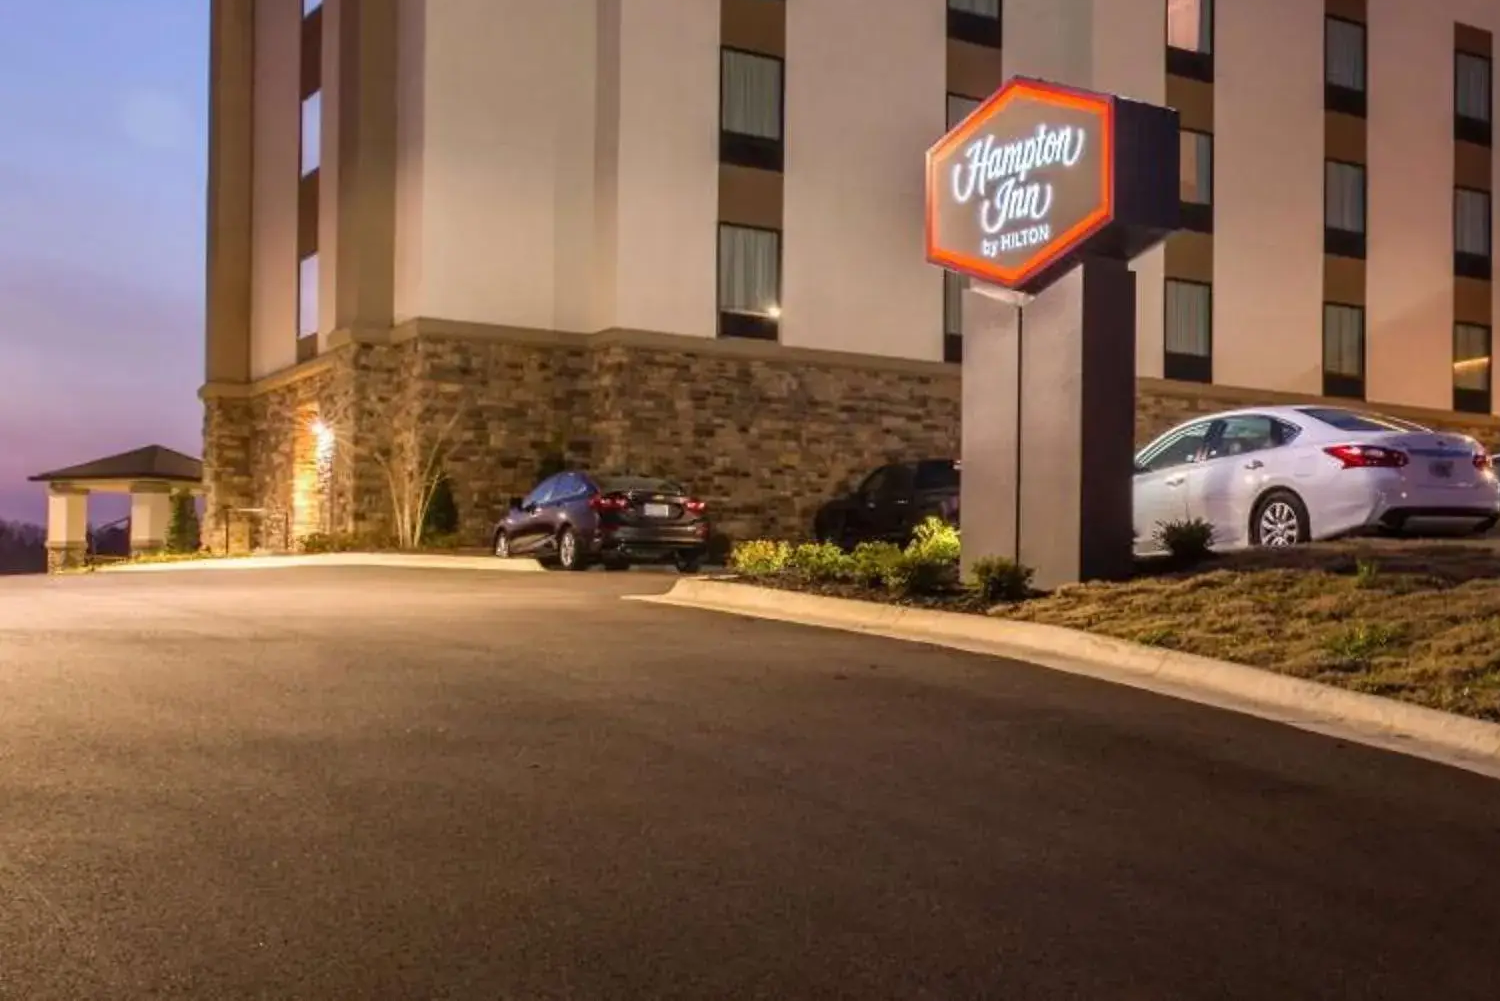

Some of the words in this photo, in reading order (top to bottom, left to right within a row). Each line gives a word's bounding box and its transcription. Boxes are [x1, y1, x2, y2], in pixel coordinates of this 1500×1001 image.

[953, 123, 1085, 203] Hampton
[980, 177, 1053, 233] Inn
[982, 239, 999, 258] by
[1000, 223, 1050, 251] HILTON
